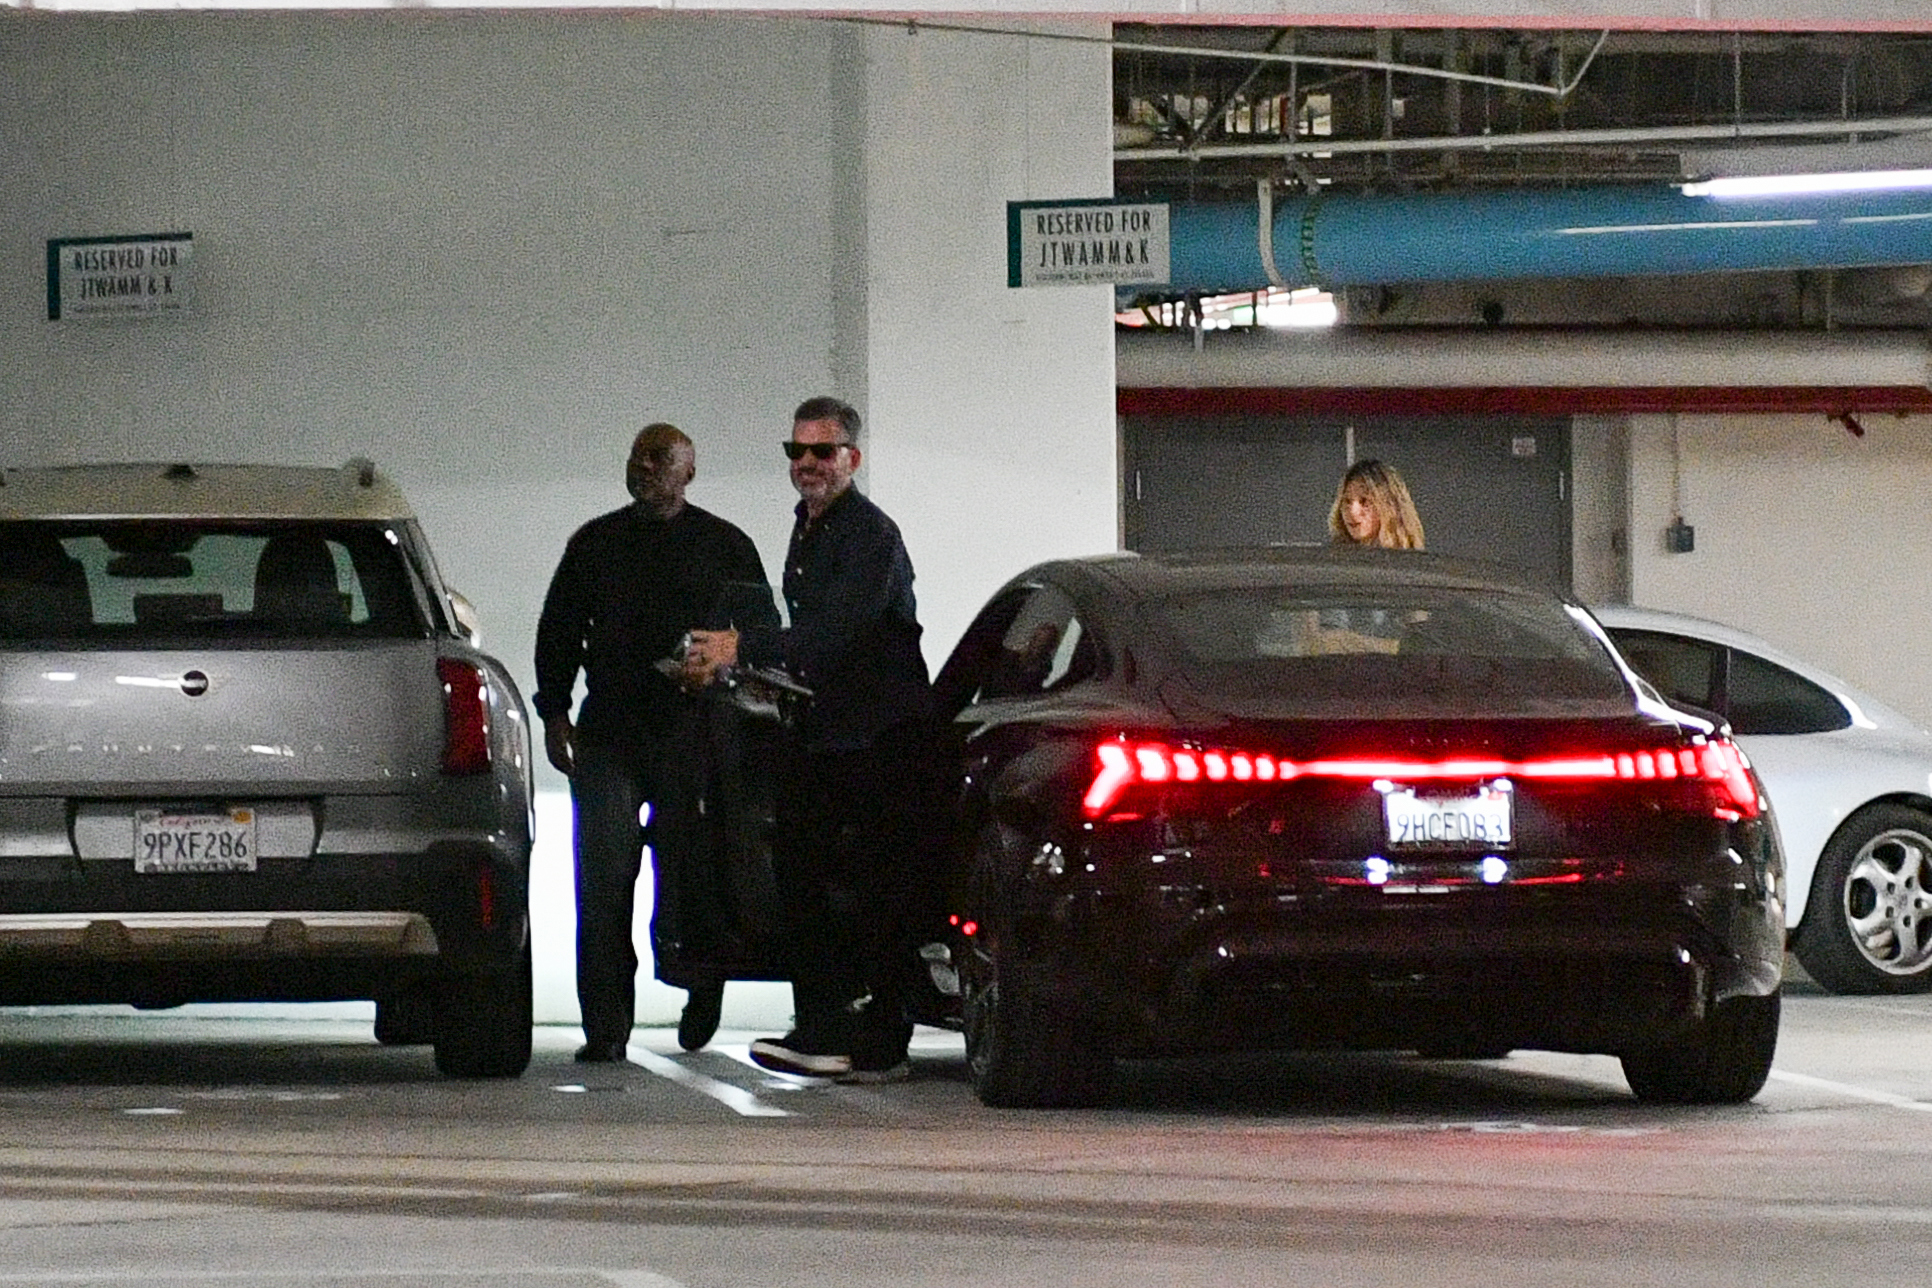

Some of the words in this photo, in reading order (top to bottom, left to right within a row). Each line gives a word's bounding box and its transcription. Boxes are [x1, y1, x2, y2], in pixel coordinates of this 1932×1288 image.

[1037, 212, 1114, 236] RESERVED
[1121, 209, 1152, 232] FOR
[74, 248, 145, 271] RESERVED
[151, 246, 178, 267] FOR
[1397, 812, 1504, 841] 9HCF083
[143, 831, 248, 859] 9PXF286
